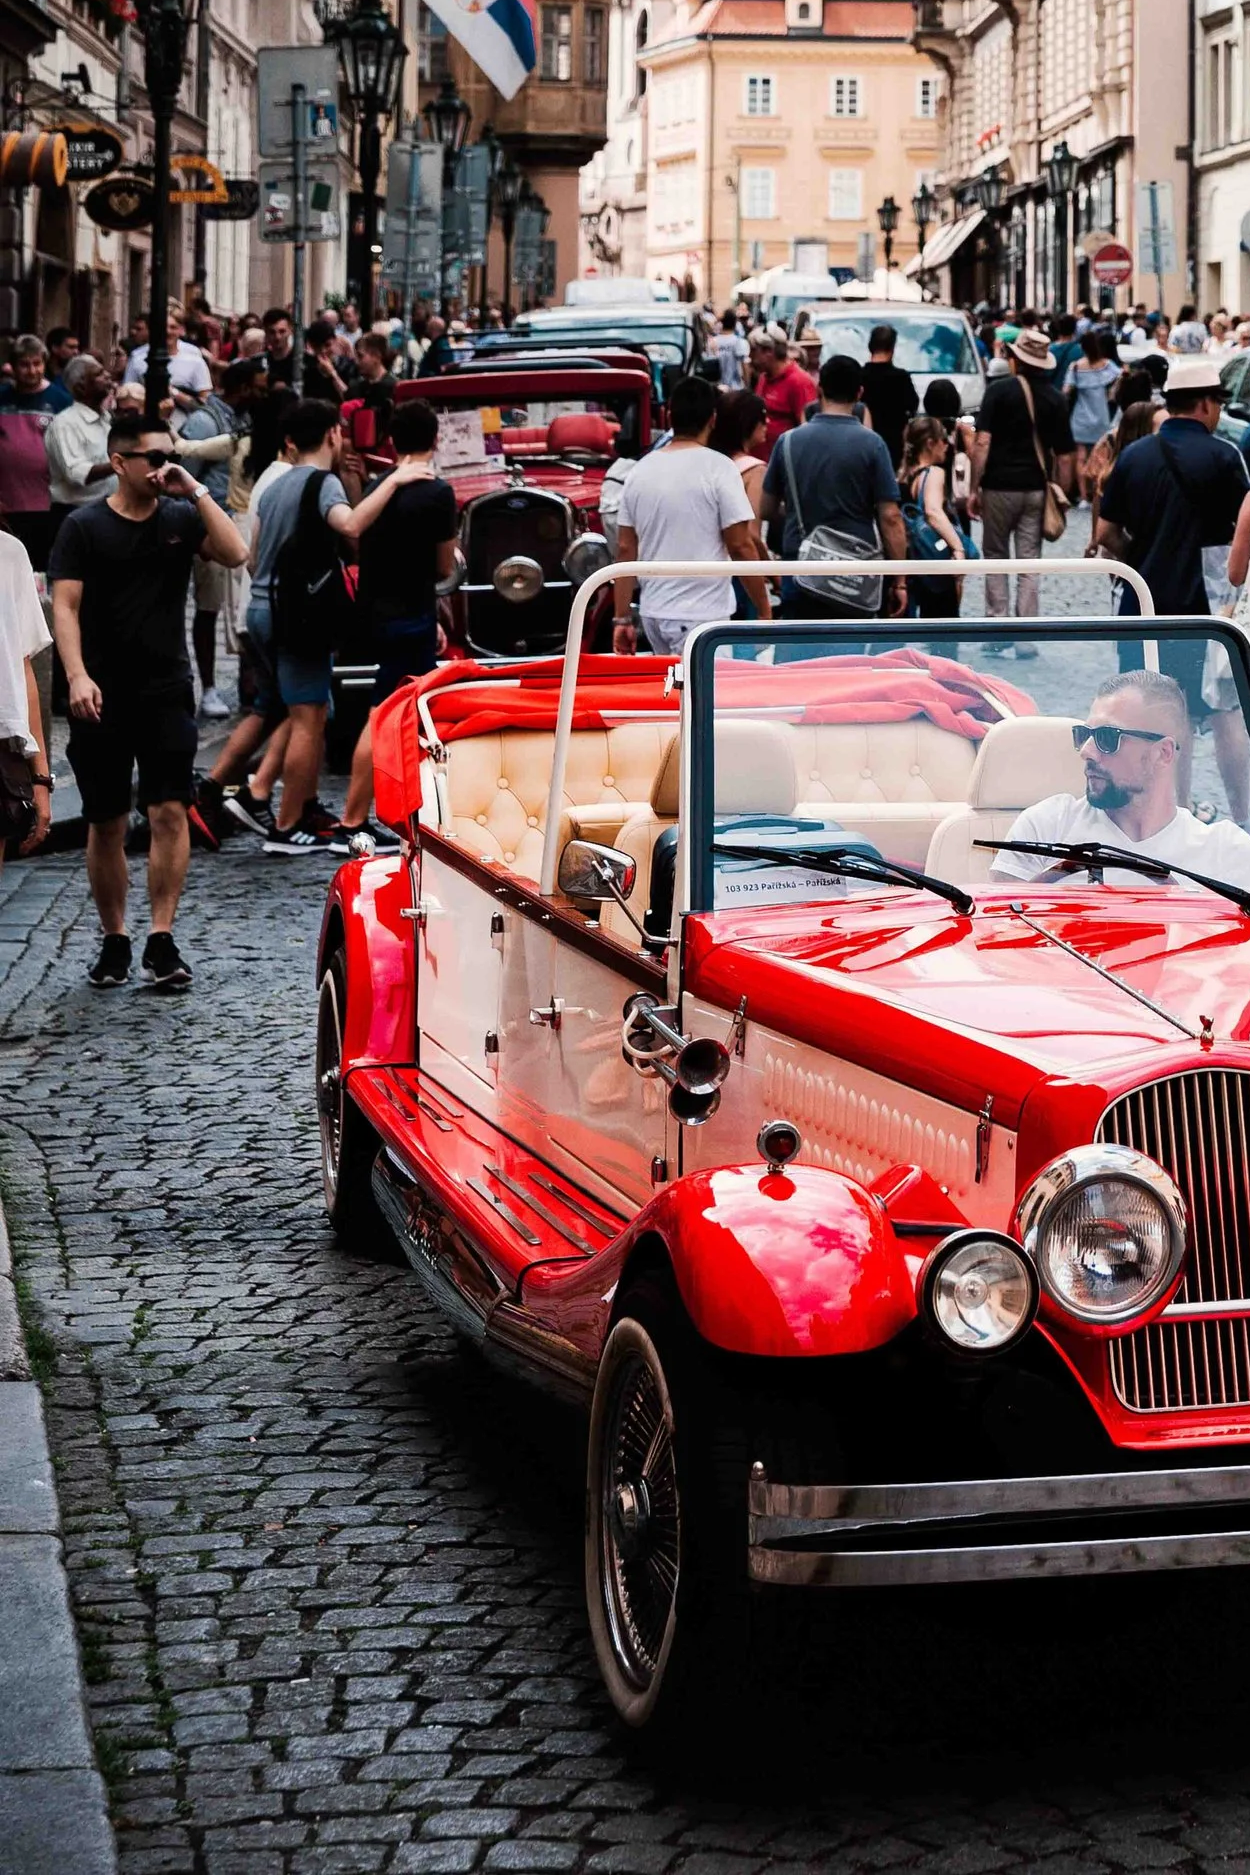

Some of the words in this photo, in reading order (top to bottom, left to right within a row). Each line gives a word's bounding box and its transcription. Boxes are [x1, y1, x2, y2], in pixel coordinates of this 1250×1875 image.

[725, 884, 741, 893] 103
[743, 882, 760, 892] 923
[761, 881, 797, 890] Pařížská
[805, 877, 841, 887] Pařížská
